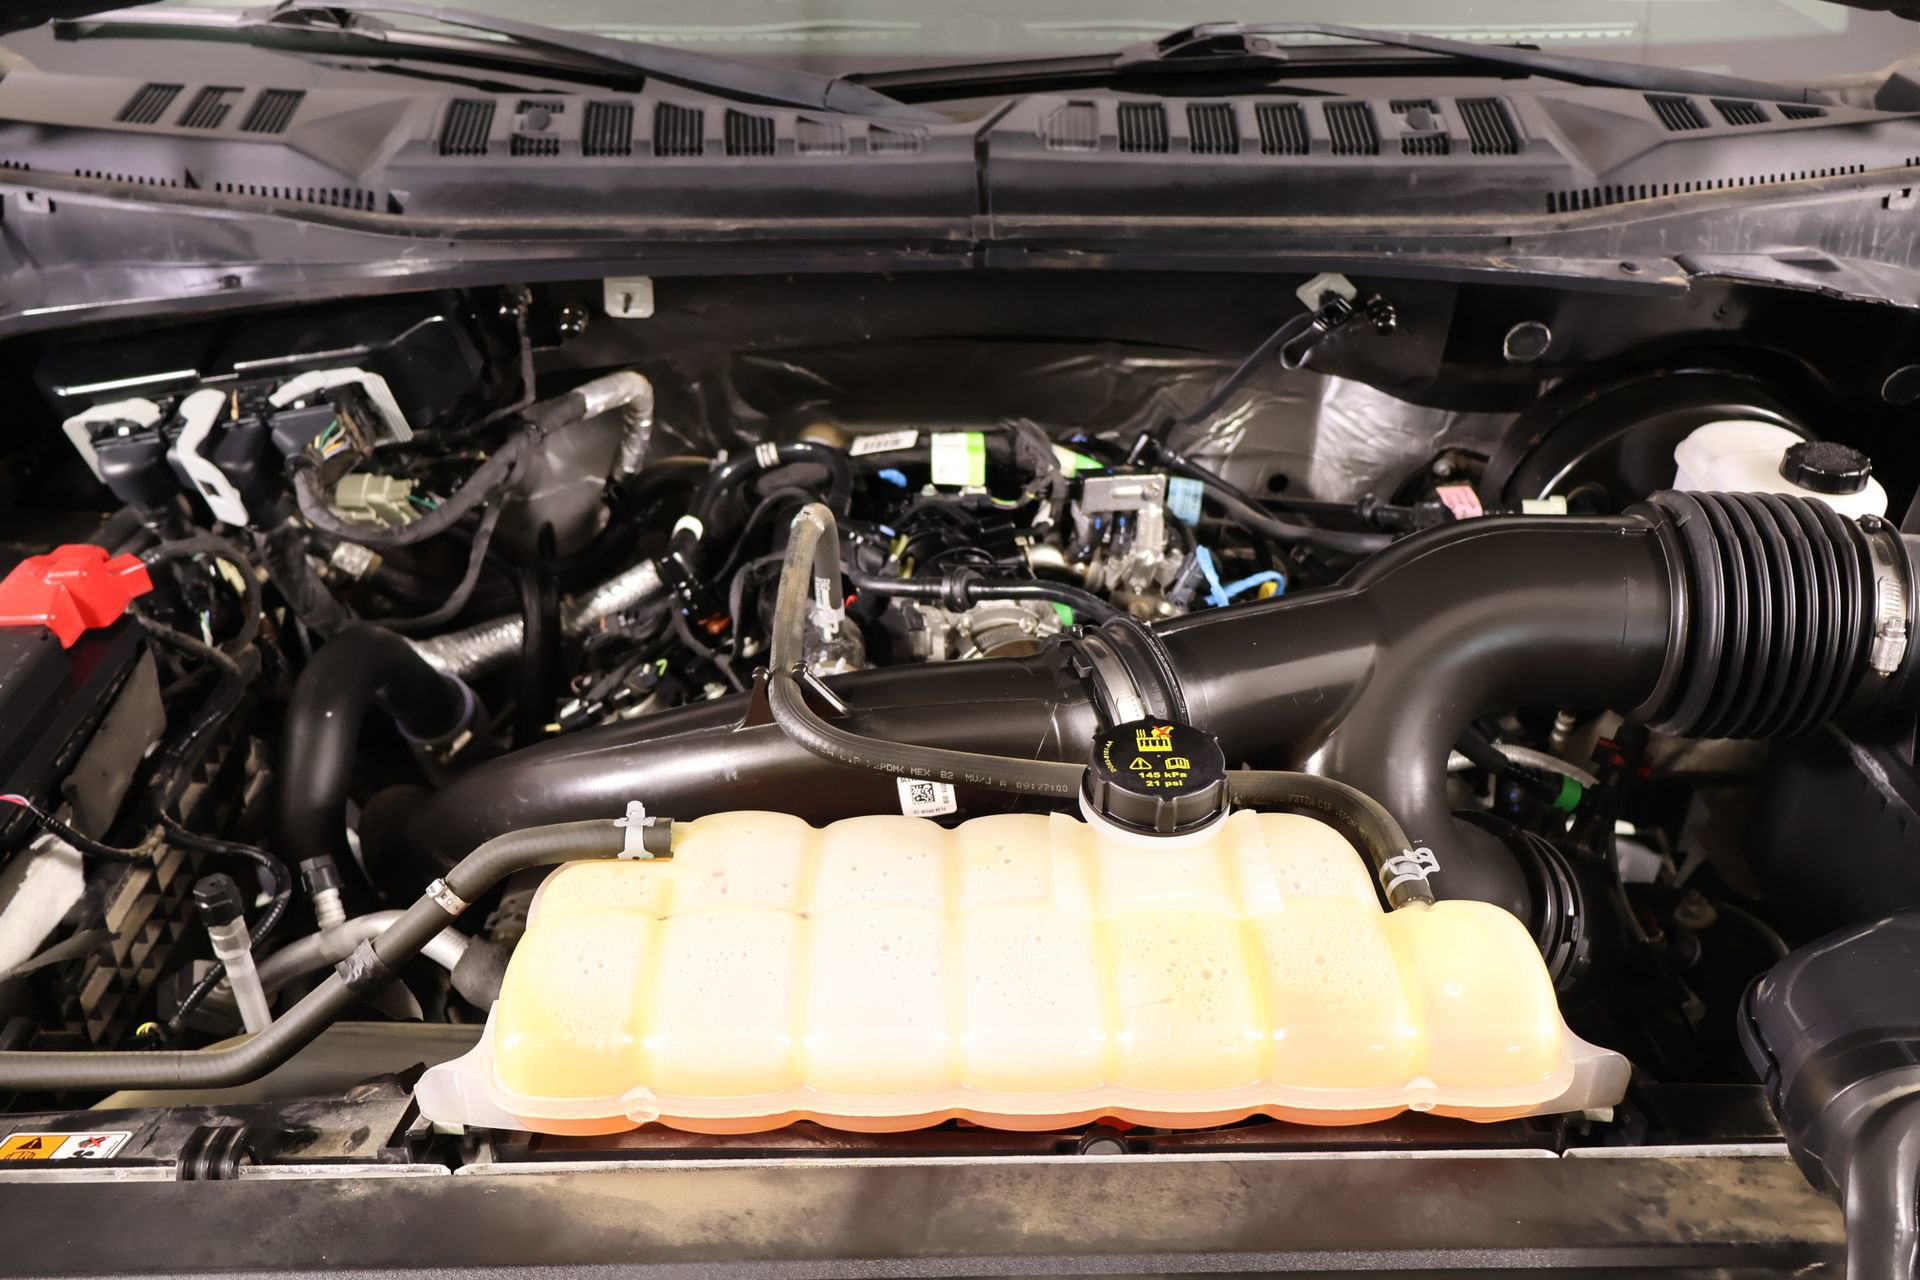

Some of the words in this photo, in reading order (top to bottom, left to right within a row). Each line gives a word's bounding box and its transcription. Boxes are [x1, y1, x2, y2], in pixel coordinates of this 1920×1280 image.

[910, 767, 931, 777] MEX
[940, 770, 954, 780] B2
[1165, 780, 1183, 788] psi
